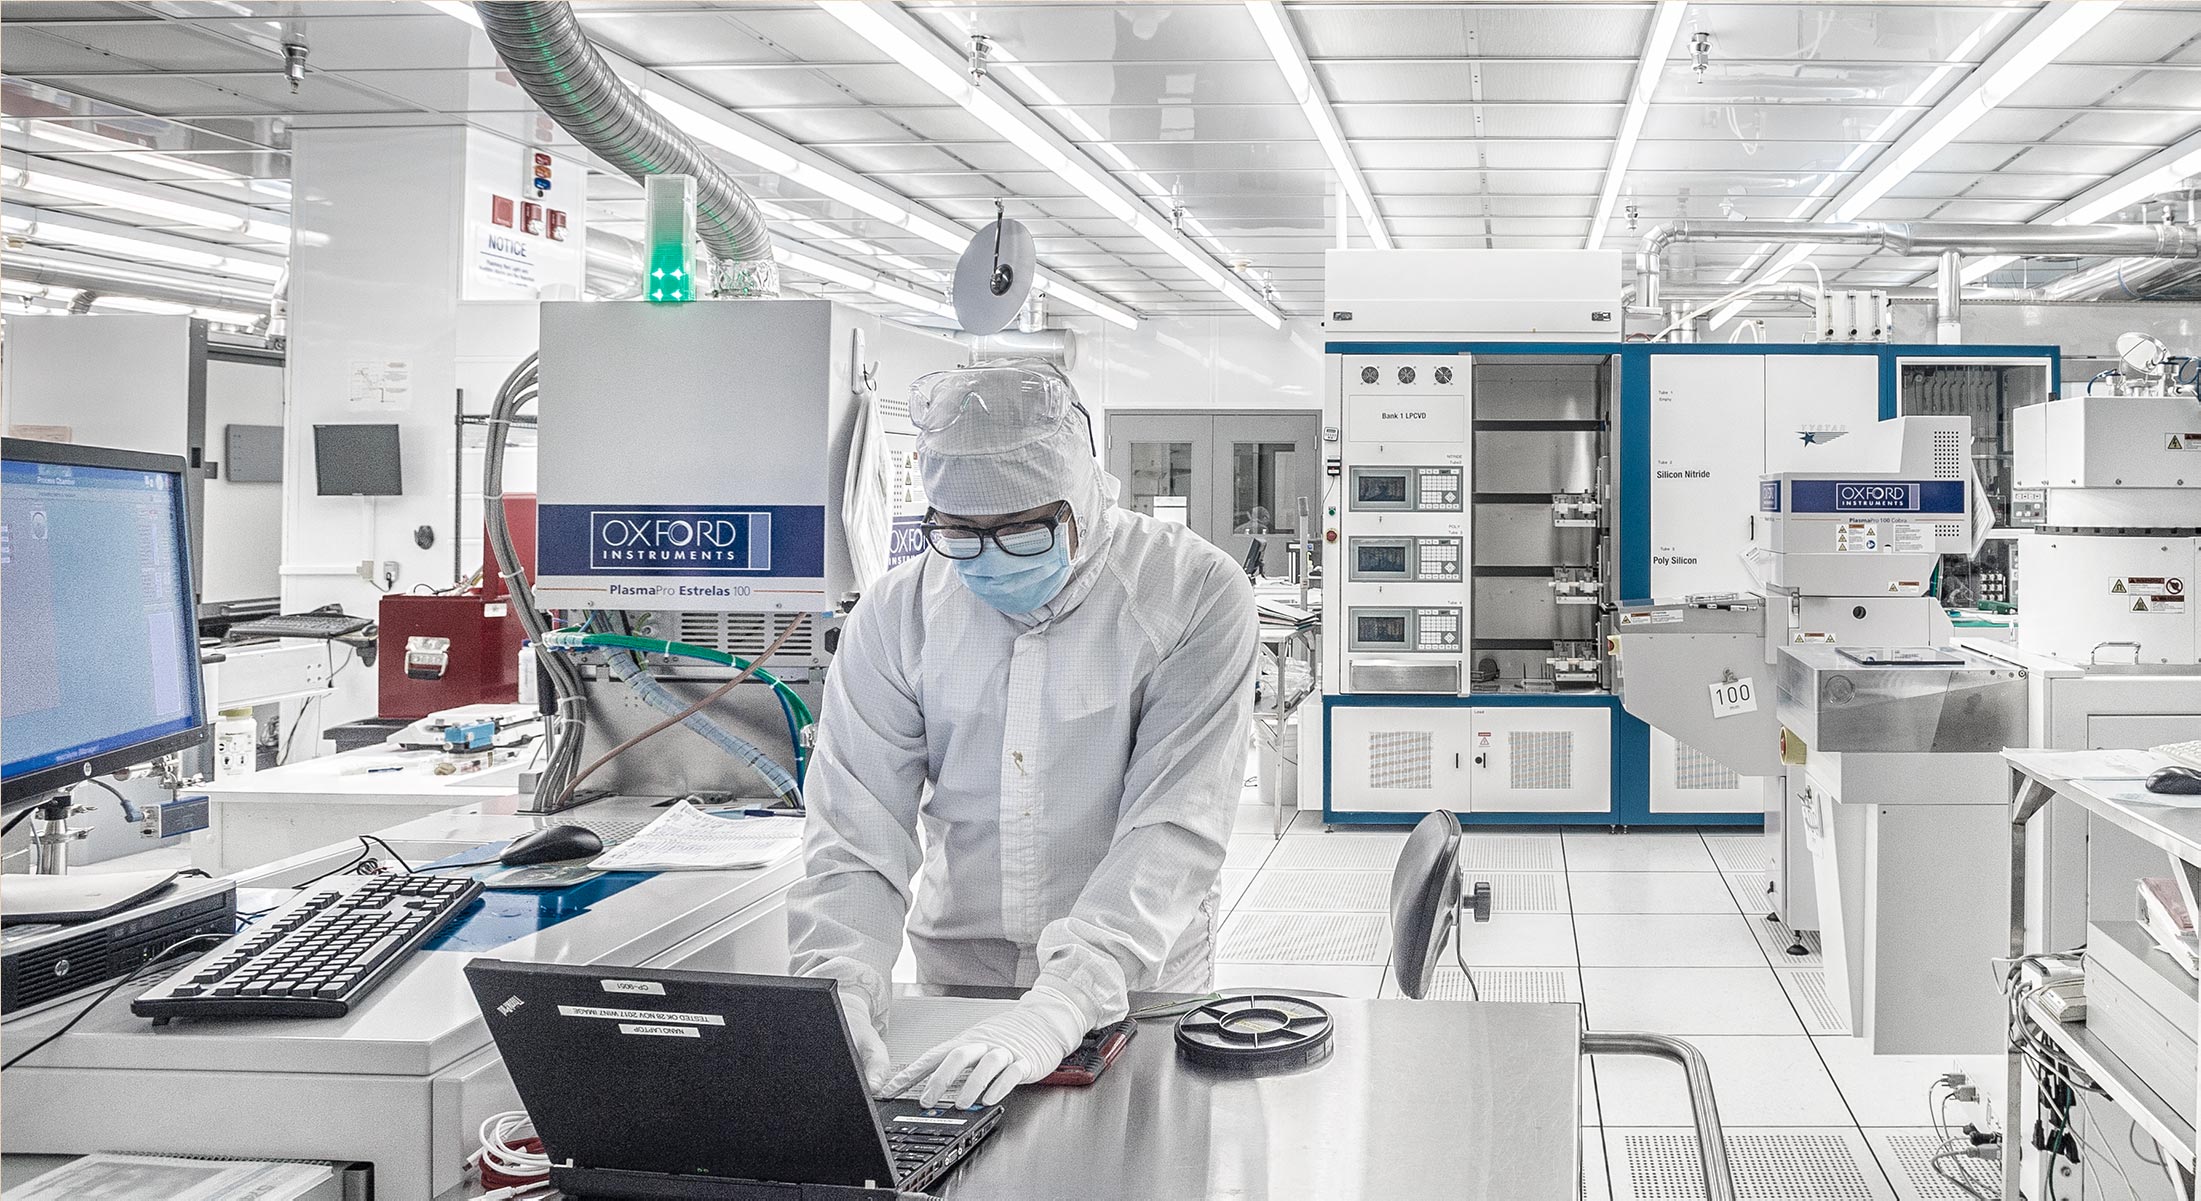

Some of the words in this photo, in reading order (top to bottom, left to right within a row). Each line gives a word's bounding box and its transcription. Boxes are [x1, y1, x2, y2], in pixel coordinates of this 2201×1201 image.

[488, 234, 527, 258] NOTICE
[1381, 412, 1399, 420] Bank
[1405, 412, 1427, 420] LPCVD
[1656, 470, 1683, 479] Silicon
[1684, 470, 1711, 478] Nitride
[1841, 486, 1904, 500] OXFORD
[602, 519, 737, 548] OXFORD
[603, 550, 735, 561] INSTRUMENTS
[1653, 556, 1670, 567] Poly
[1671, 556, 1698, 565] Silicon
[610, 584, 675, 597] PlasmaPro
[679, 585, 731, 597] Estrelas
[733, 586, 750, 596] 100
[1715, 684, 1750, 706] 100
[620, 1010, 638, 1018] 2017
[639, 1011, 656, 1019] NOV
[655, 1012, 666, 1020] 28
[667, 1013, 679, 1021] OK
[679, 1014, 710, 1023] TESTED
[634, 1026, 662, 1034] LAPTOP
[662, 1026, 685, 1034] NANO
